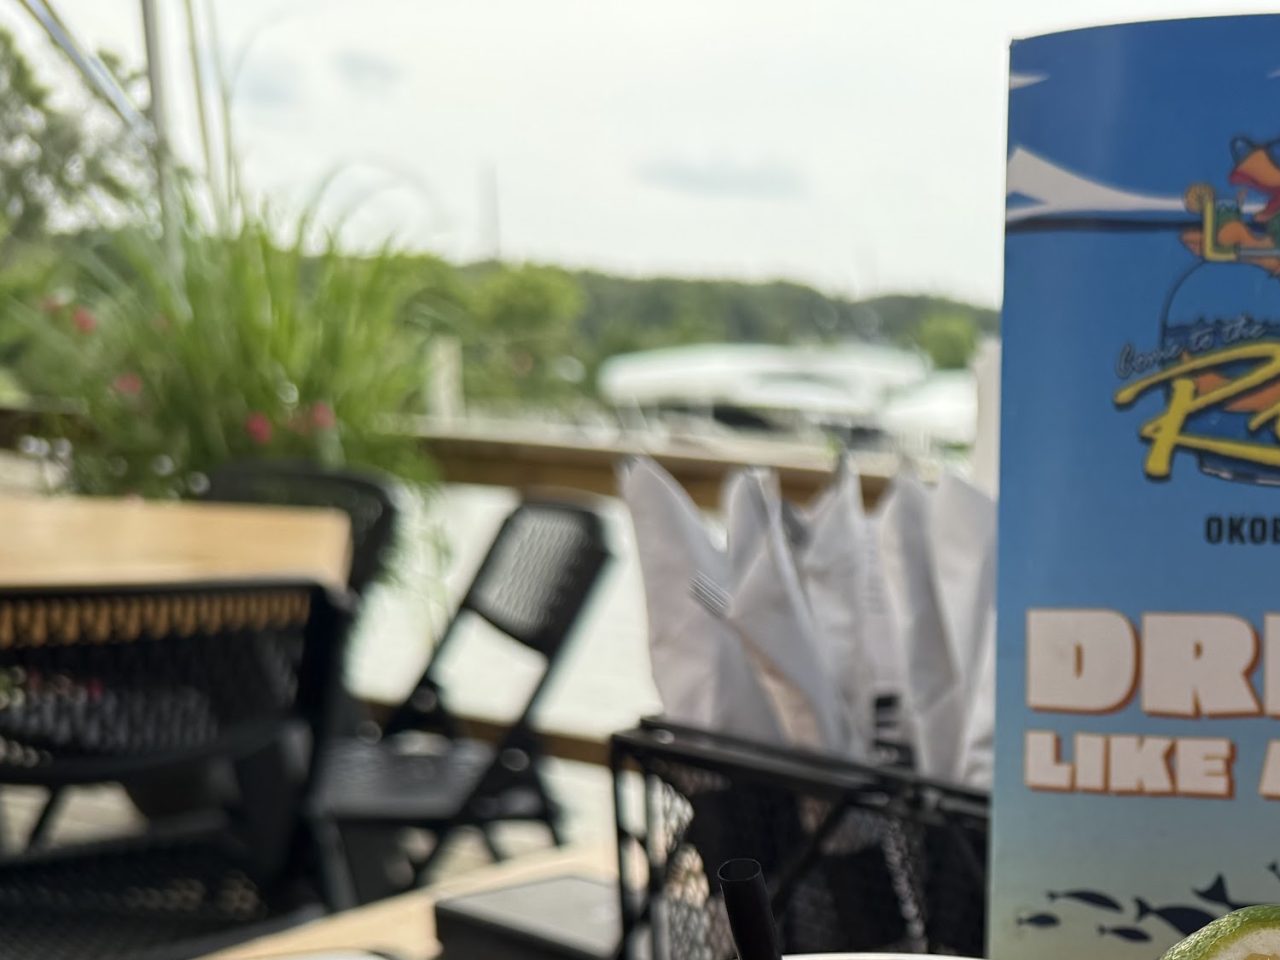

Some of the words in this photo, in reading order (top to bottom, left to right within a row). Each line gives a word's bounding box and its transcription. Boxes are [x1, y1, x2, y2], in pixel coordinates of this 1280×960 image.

[1190, 325, 1214, 348] to
[1221, 315, 1266, 342] the
[1024, 730, 1236, 799] LIKE
